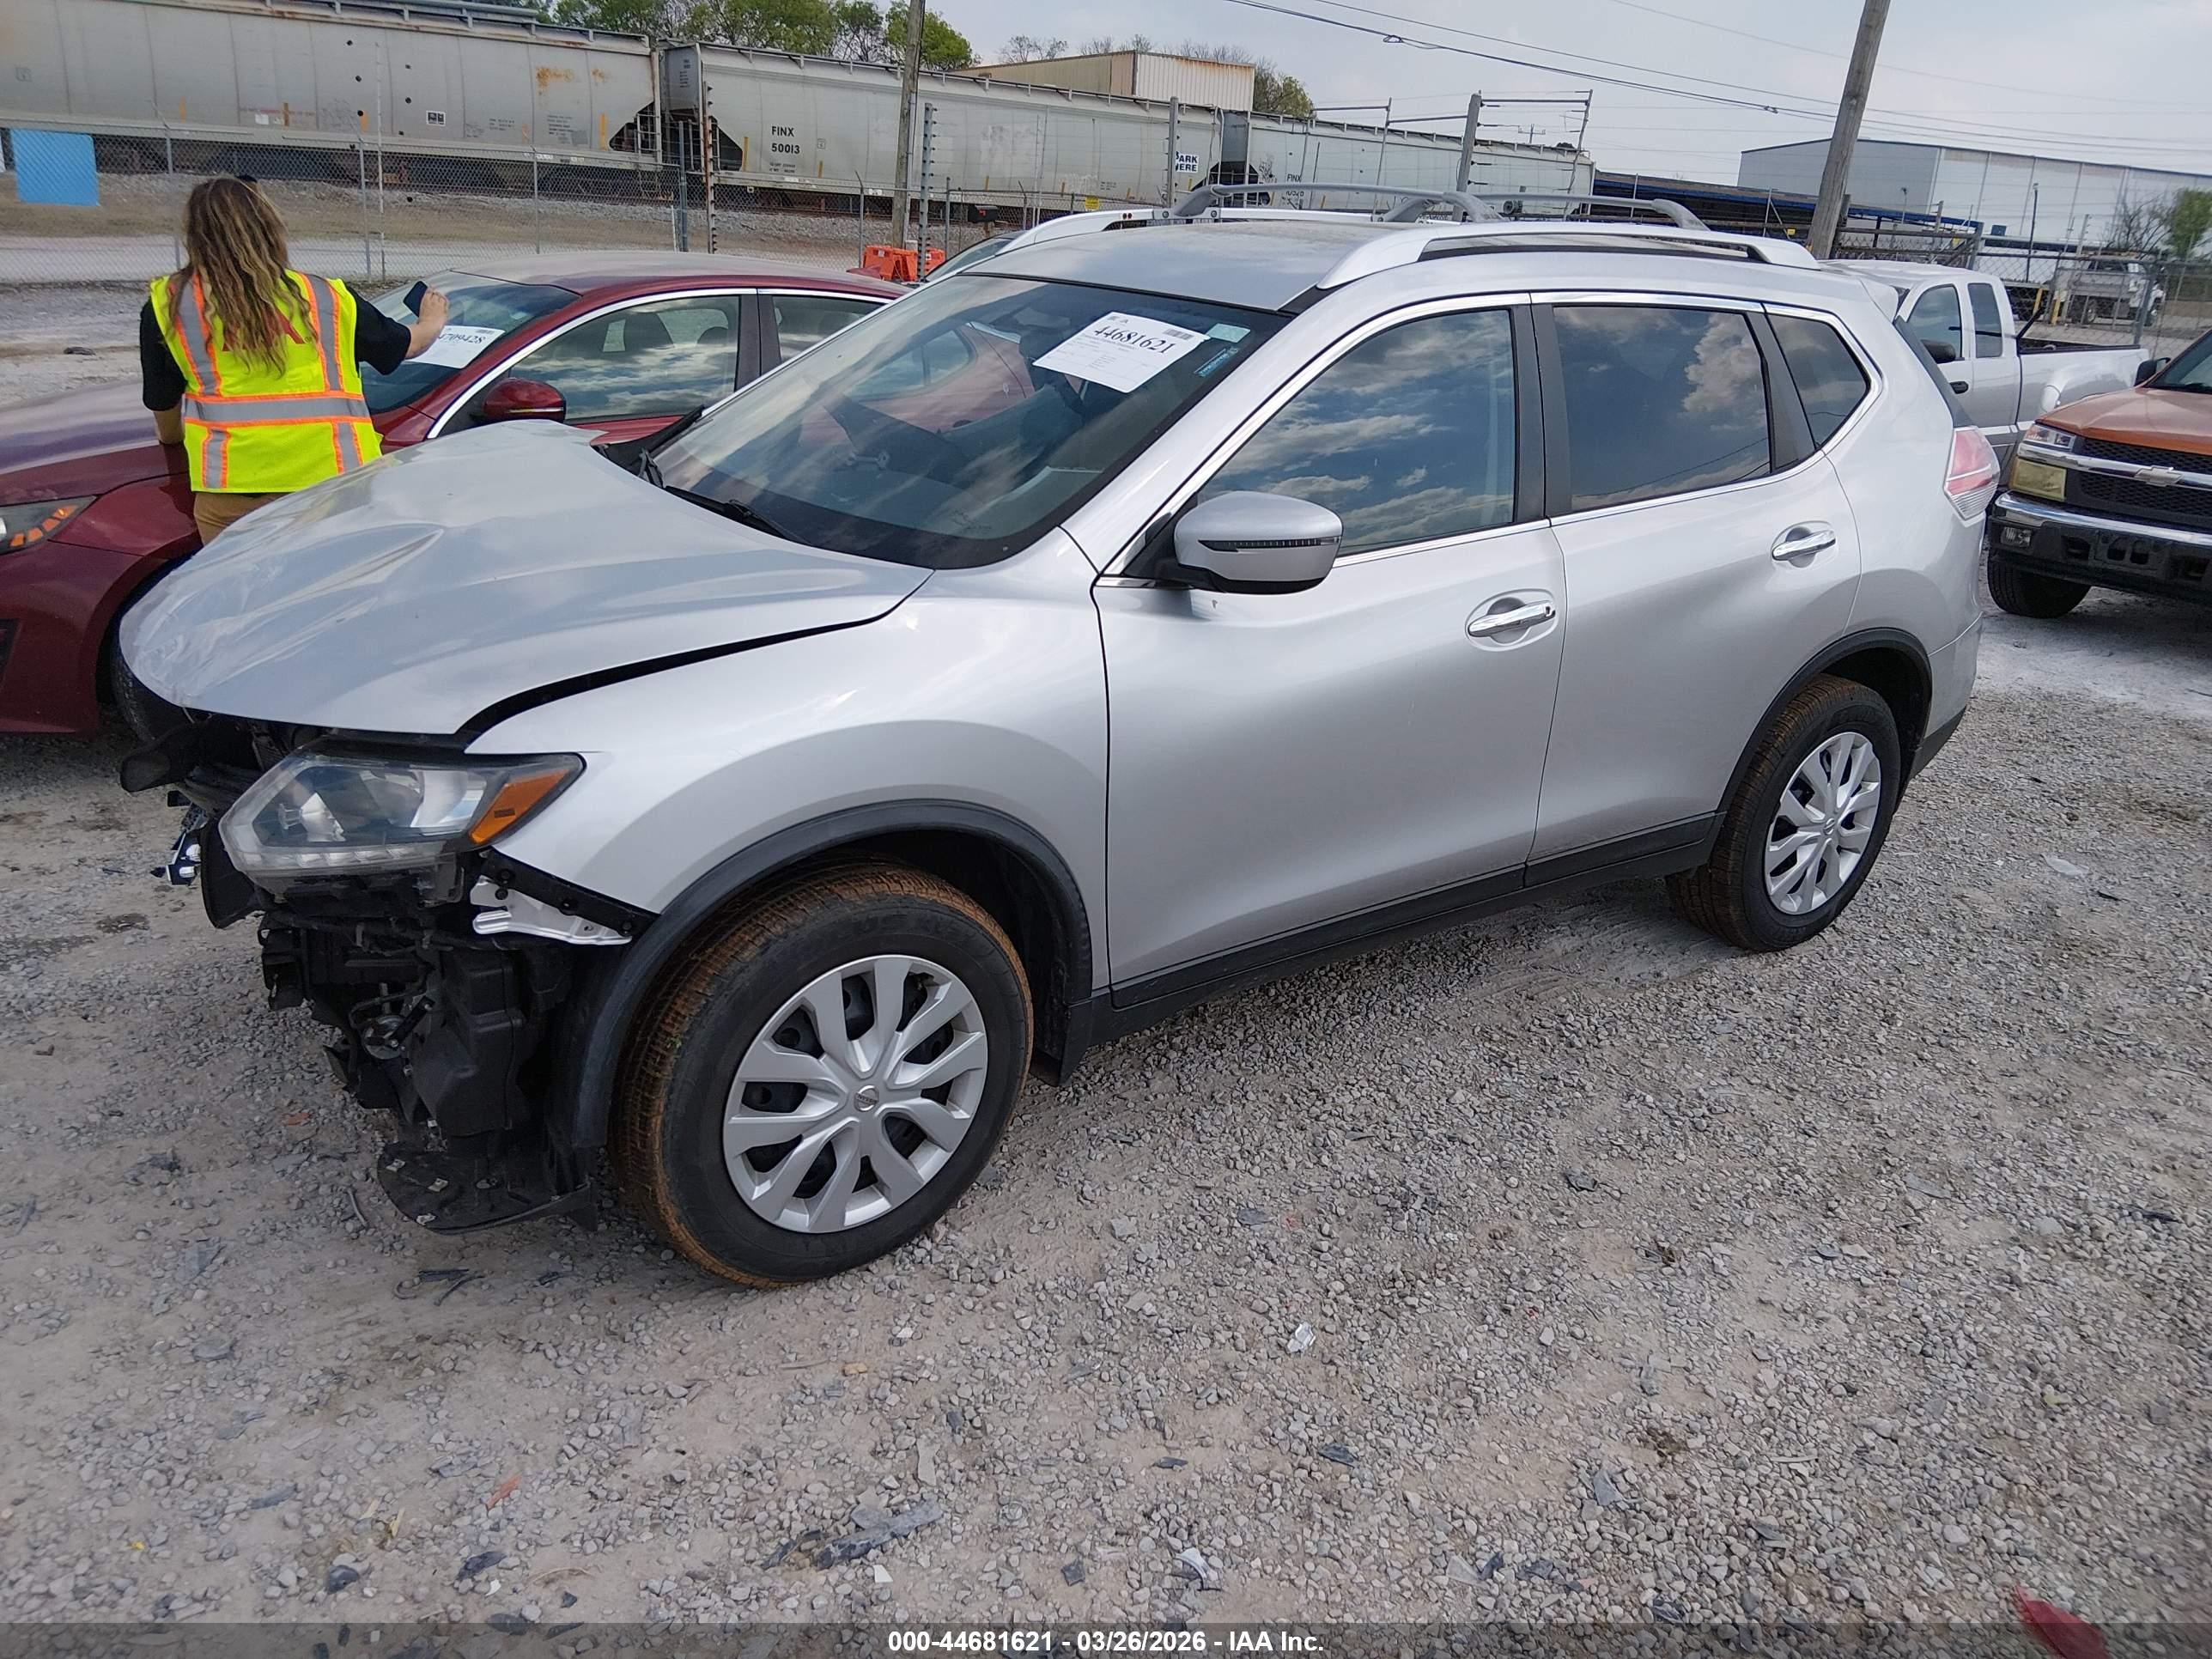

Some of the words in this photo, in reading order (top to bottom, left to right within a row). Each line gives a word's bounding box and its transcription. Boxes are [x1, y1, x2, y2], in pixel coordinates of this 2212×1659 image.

[771, 125, 795, 138] FINX
[771, 143, 800, 155] 50013
[1287, 173, 1302, 182] FINX
[1094, 325, 1176, 354] 44681621
